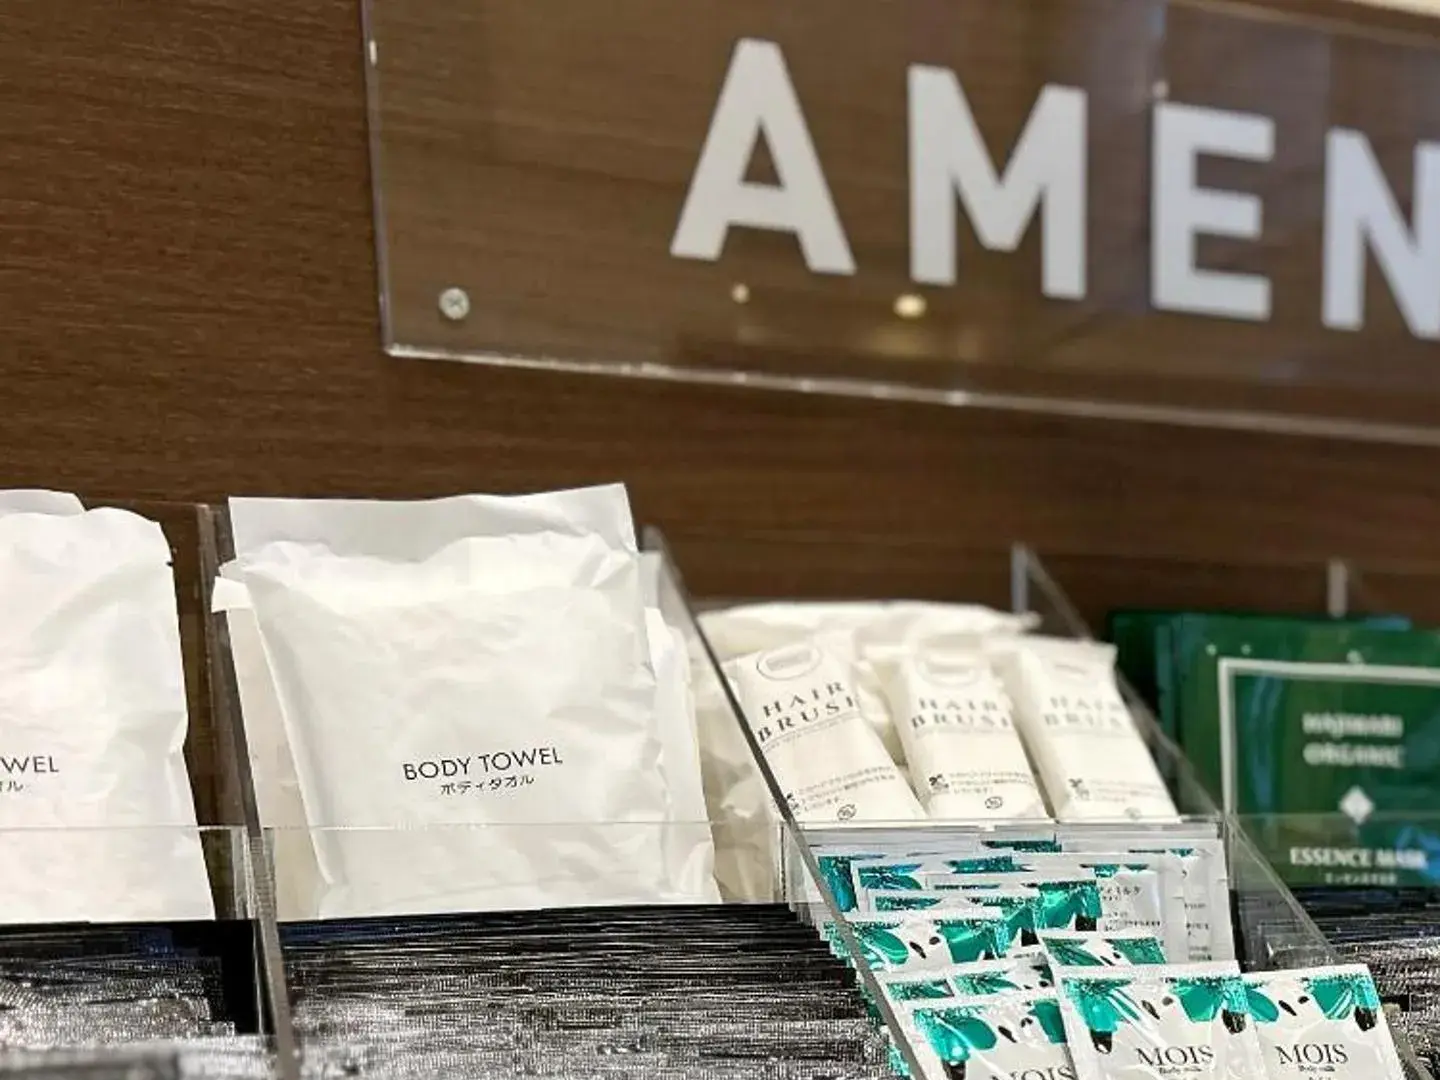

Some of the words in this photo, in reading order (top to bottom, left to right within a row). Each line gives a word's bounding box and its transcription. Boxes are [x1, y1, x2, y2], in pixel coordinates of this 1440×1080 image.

[763, 681, 845, 719] HAIR
[402, 756, 471, 781] BODY
[478, 747, 564, 773] TOWEL
[1289, 847, 1372, 868] ESSENCE
[1135, 1044, 1214, 1067] MOIS
[1274, 1043, 1349, 1065] MOIS
